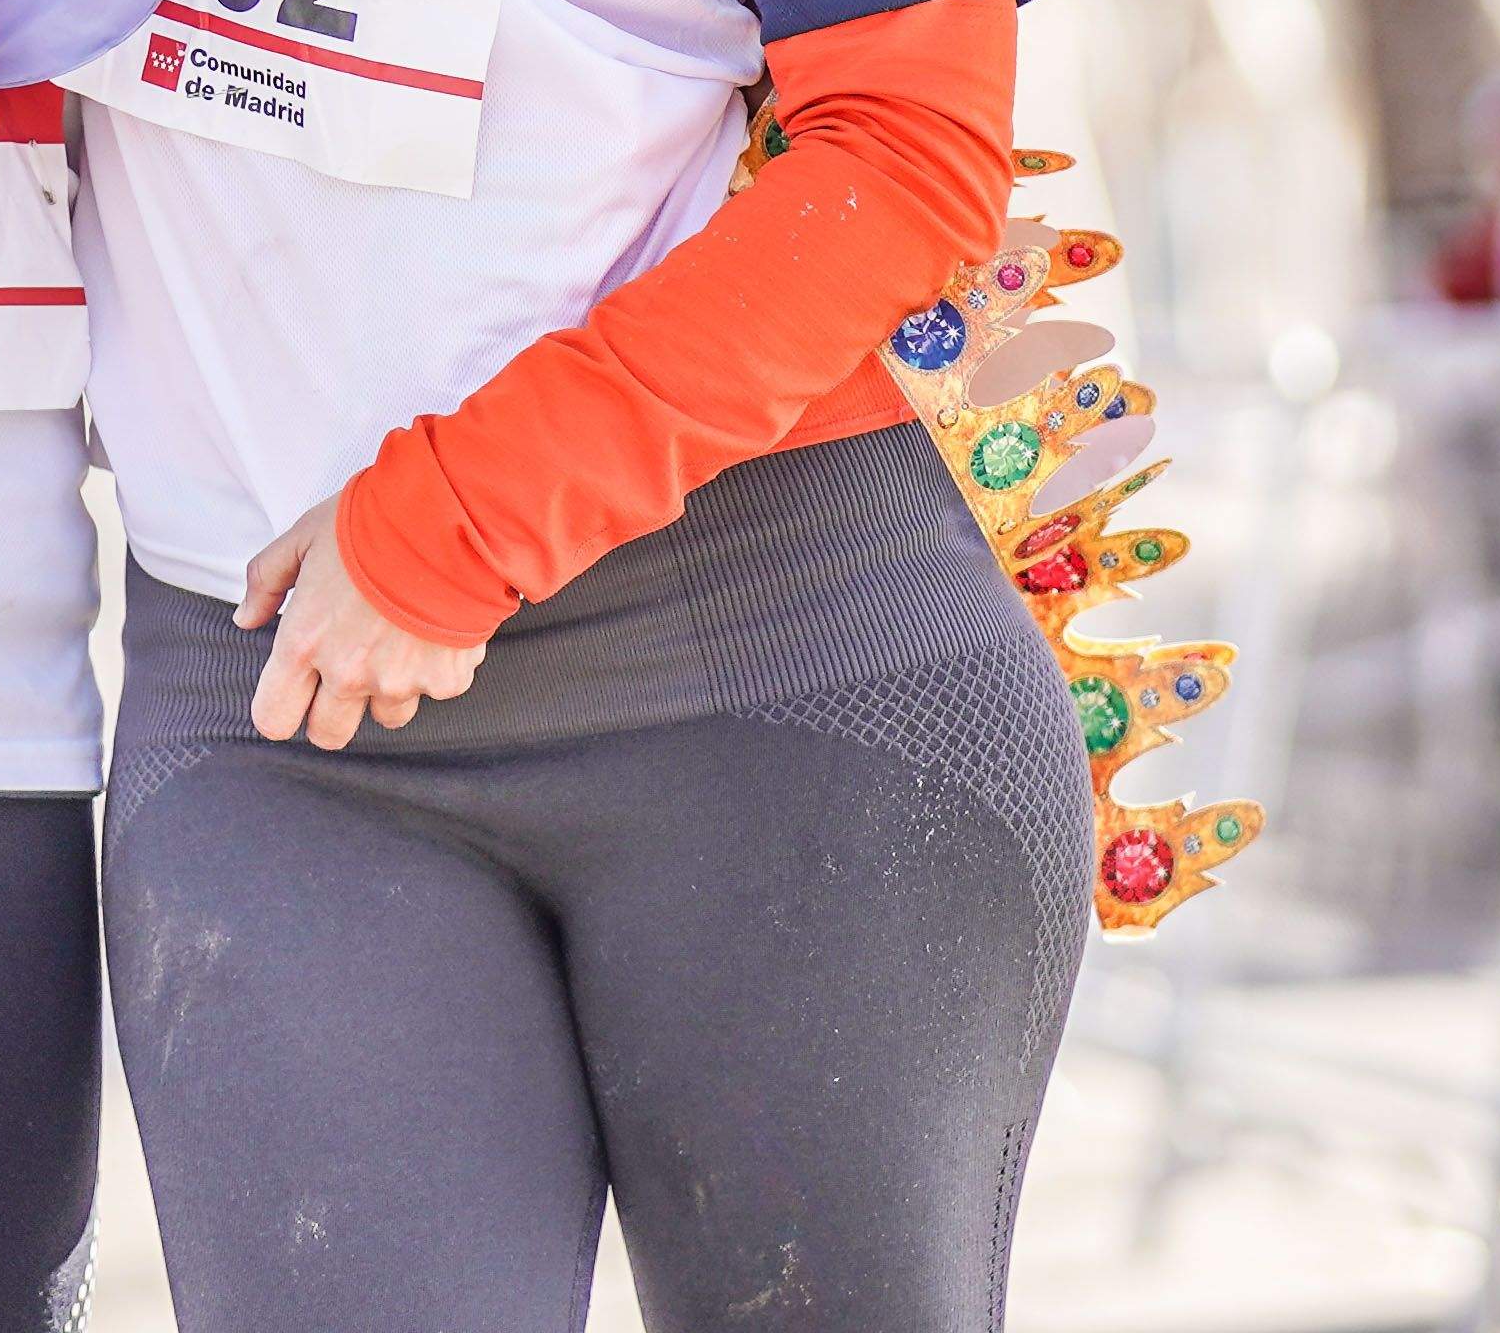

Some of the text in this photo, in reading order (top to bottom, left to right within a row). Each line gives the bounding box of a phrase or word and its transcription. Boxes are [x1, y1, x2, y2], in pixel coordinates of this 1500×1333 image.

[190, 48, 307, 100] Comunidad
[185, 76, 305, 128] de Madrid
